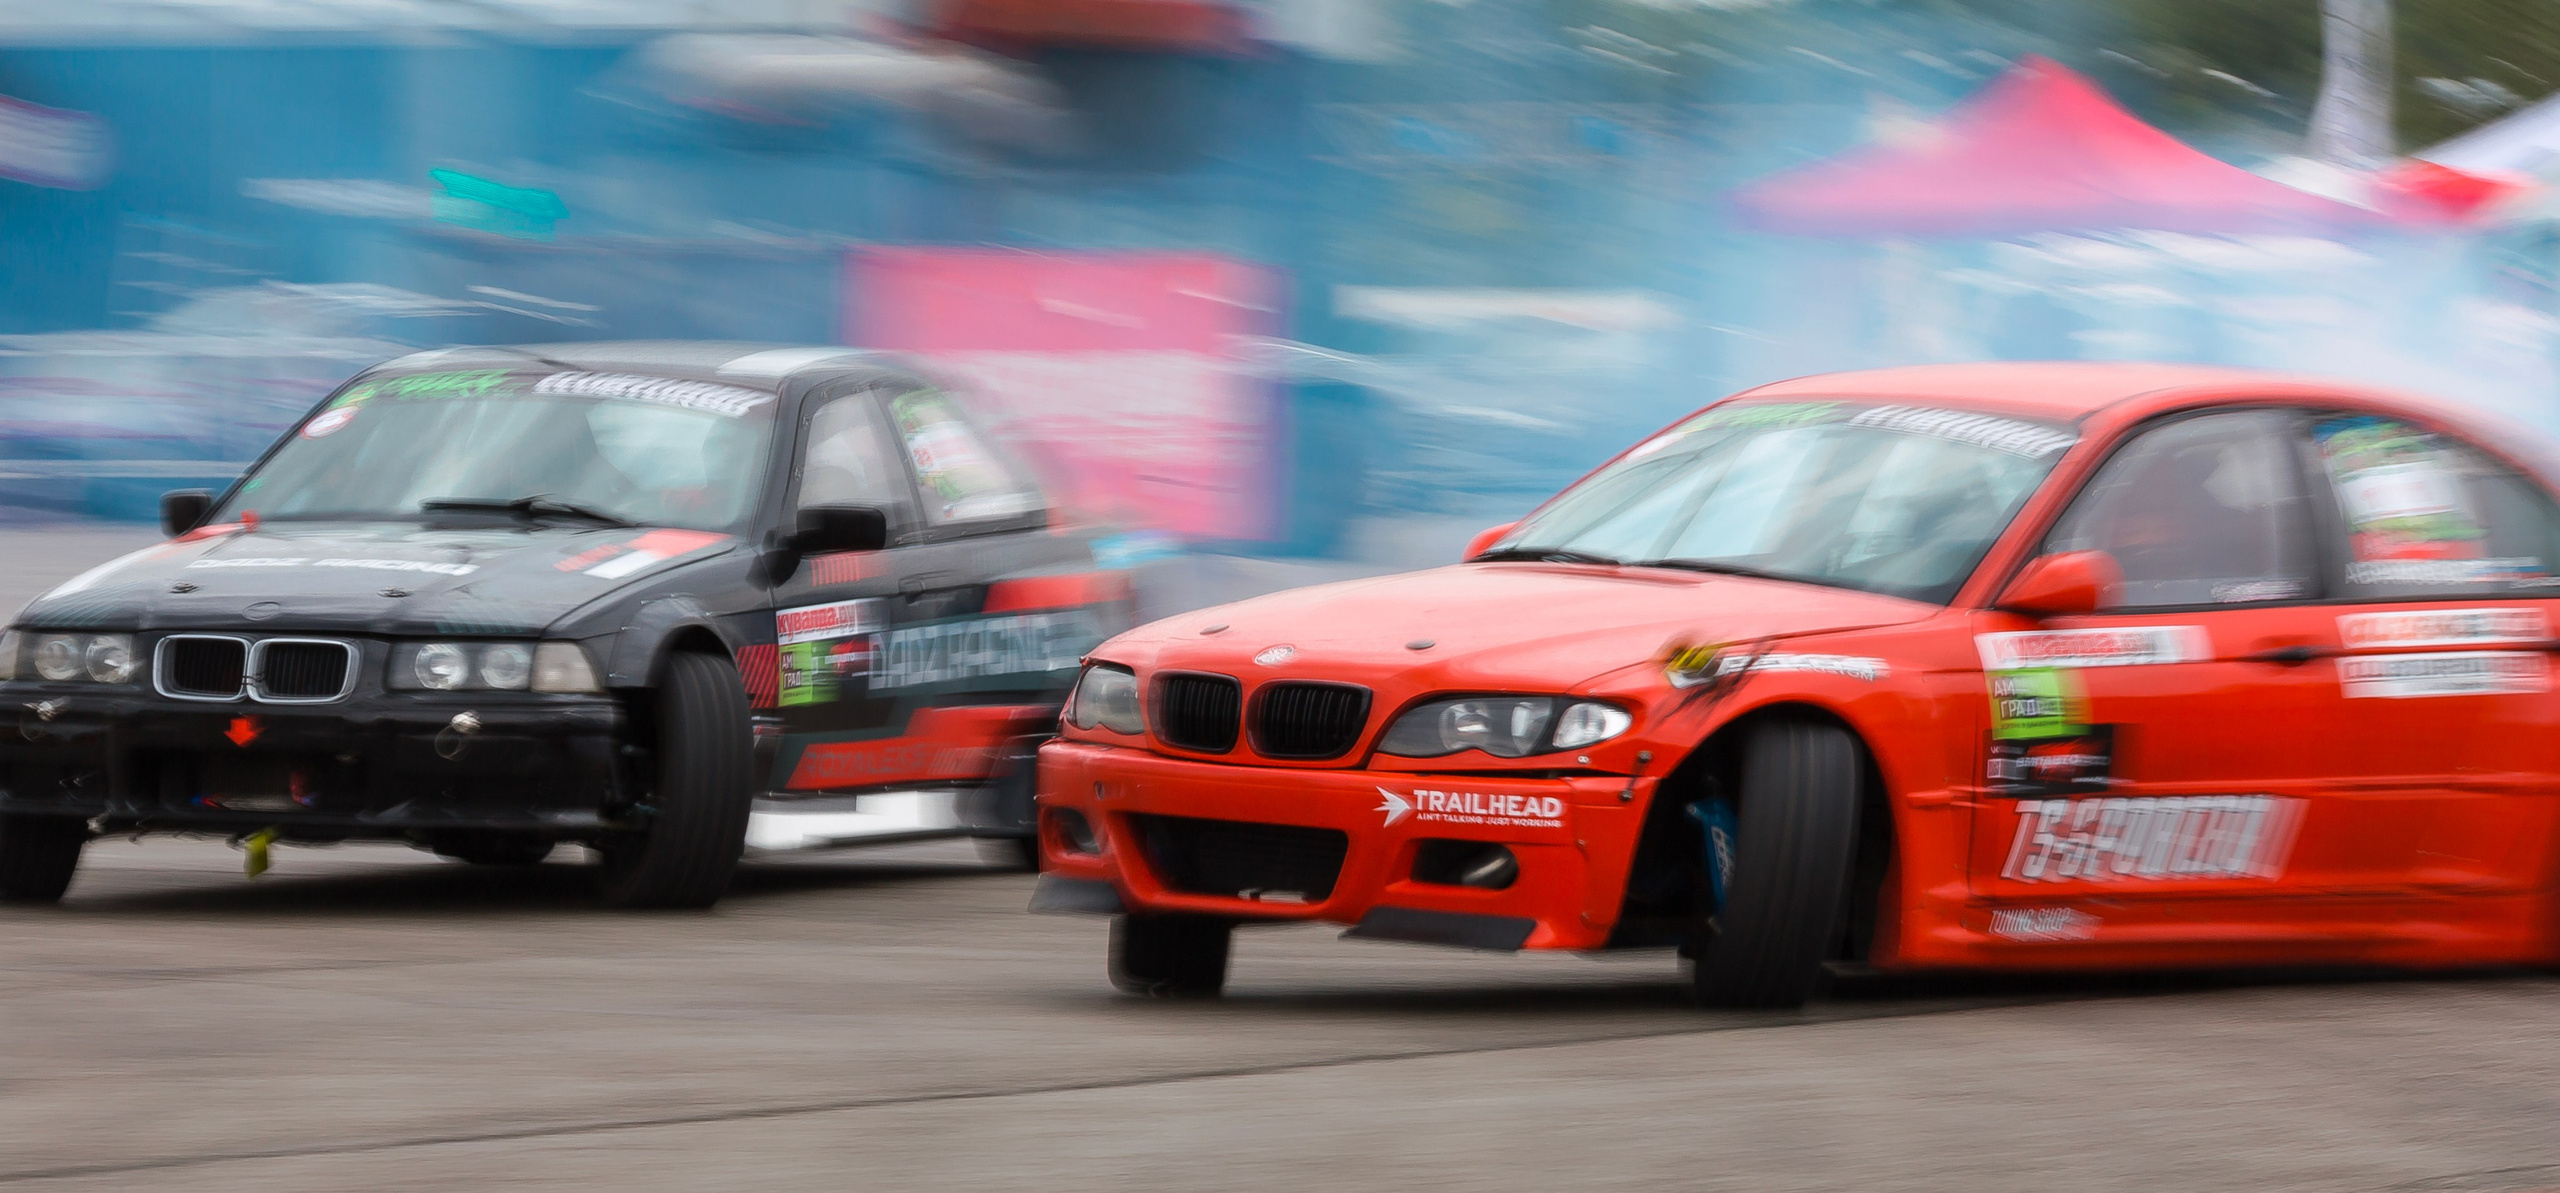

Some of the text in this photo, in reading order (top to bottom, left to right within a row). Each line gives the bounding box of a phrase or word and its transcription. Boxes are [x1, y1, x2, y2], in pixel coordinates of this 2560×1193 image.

[312, 558, 480, 577] RACING
[1994, 680, 2015, 697] АМ
[2000, 699, 2039, 719] ГРАД
[1413, 790, 1563, 818] TRAILHEAD
[1417, 812, 1562, 828] AIN'T TALKING JUST WORKING
[1988, 907, 2071, 934] TUNING SHOP
